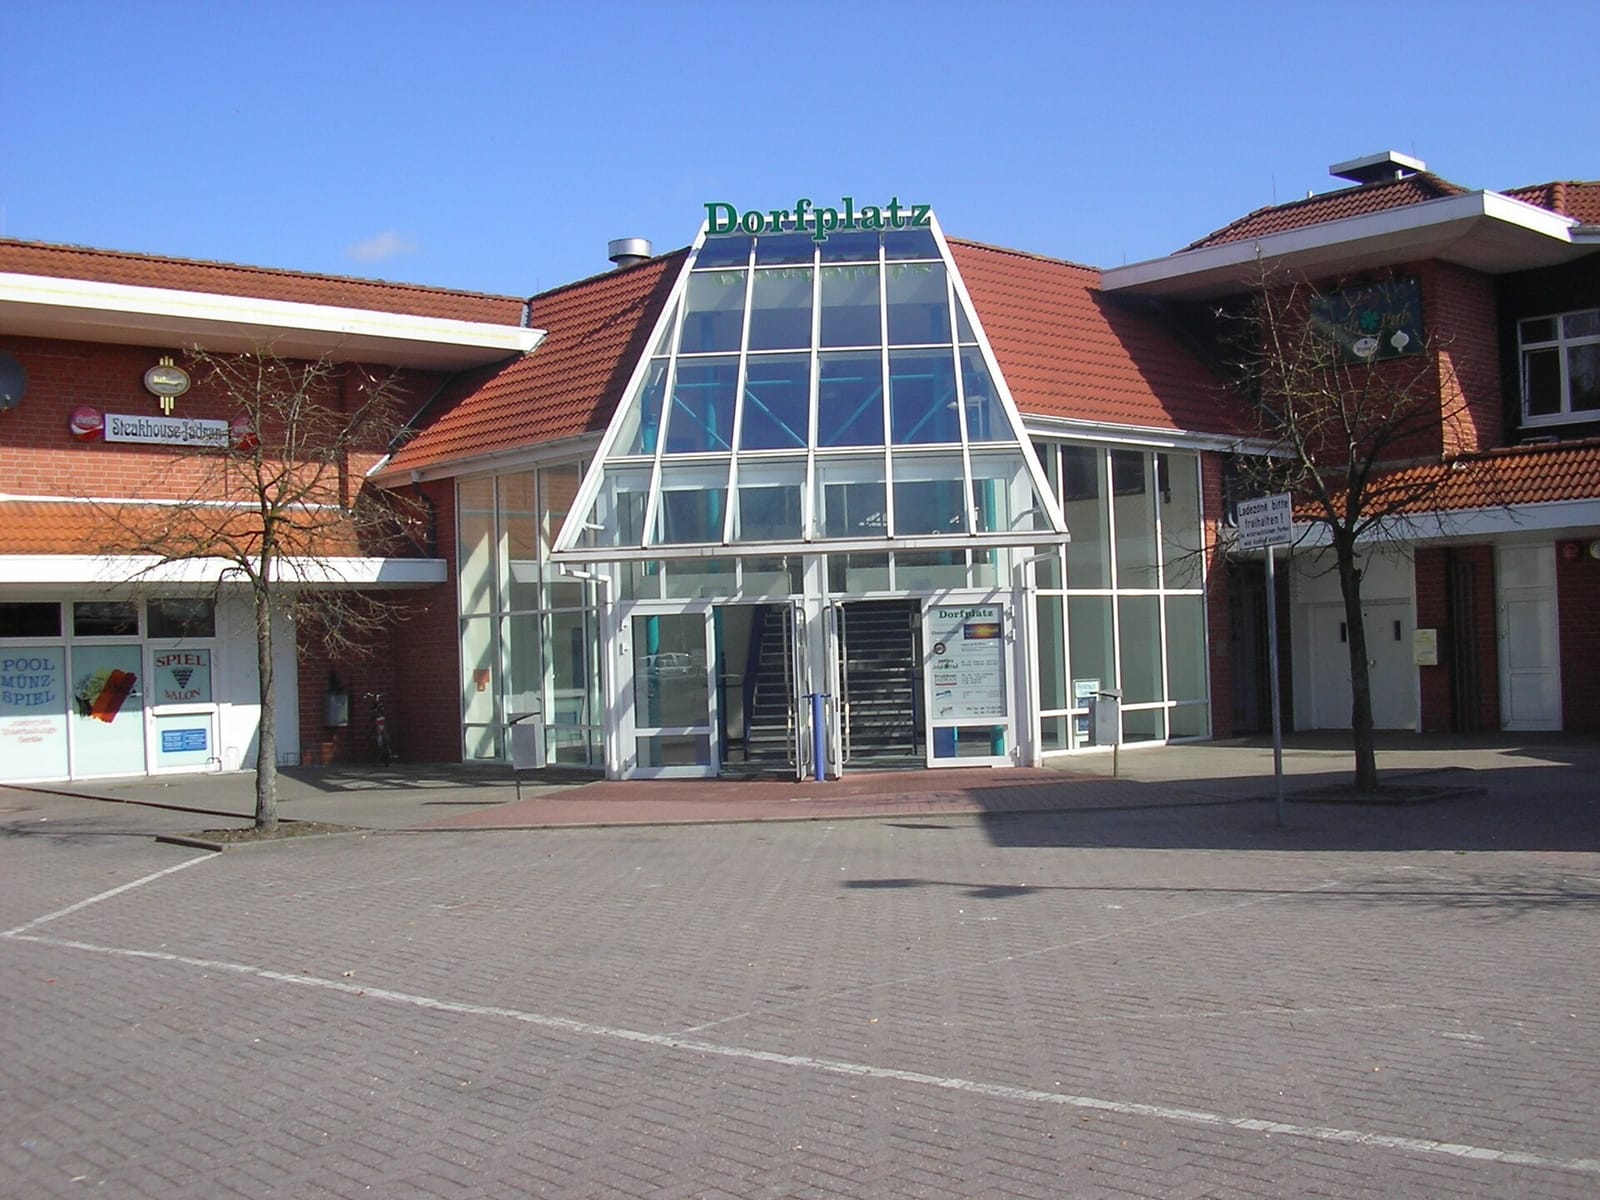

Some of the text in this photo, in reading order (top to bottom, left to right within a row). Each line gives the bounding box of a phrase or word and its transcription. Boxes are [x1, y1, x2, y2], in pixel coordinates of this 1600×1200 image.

[703, 197, 931, 241] Dorfplatz
[1239, 499, 1288, 516] Ladezone bitte
[939, 609, 993, 619] Dorfplatz
[3, 658, 55, 671] POOL
[156, 654, 206, 668] SPIEL
[1, 674, 56, 689] MÜNZ-
[2, 690, 55, 706] SPIEL
[164, 688, 200, 700] SALON
